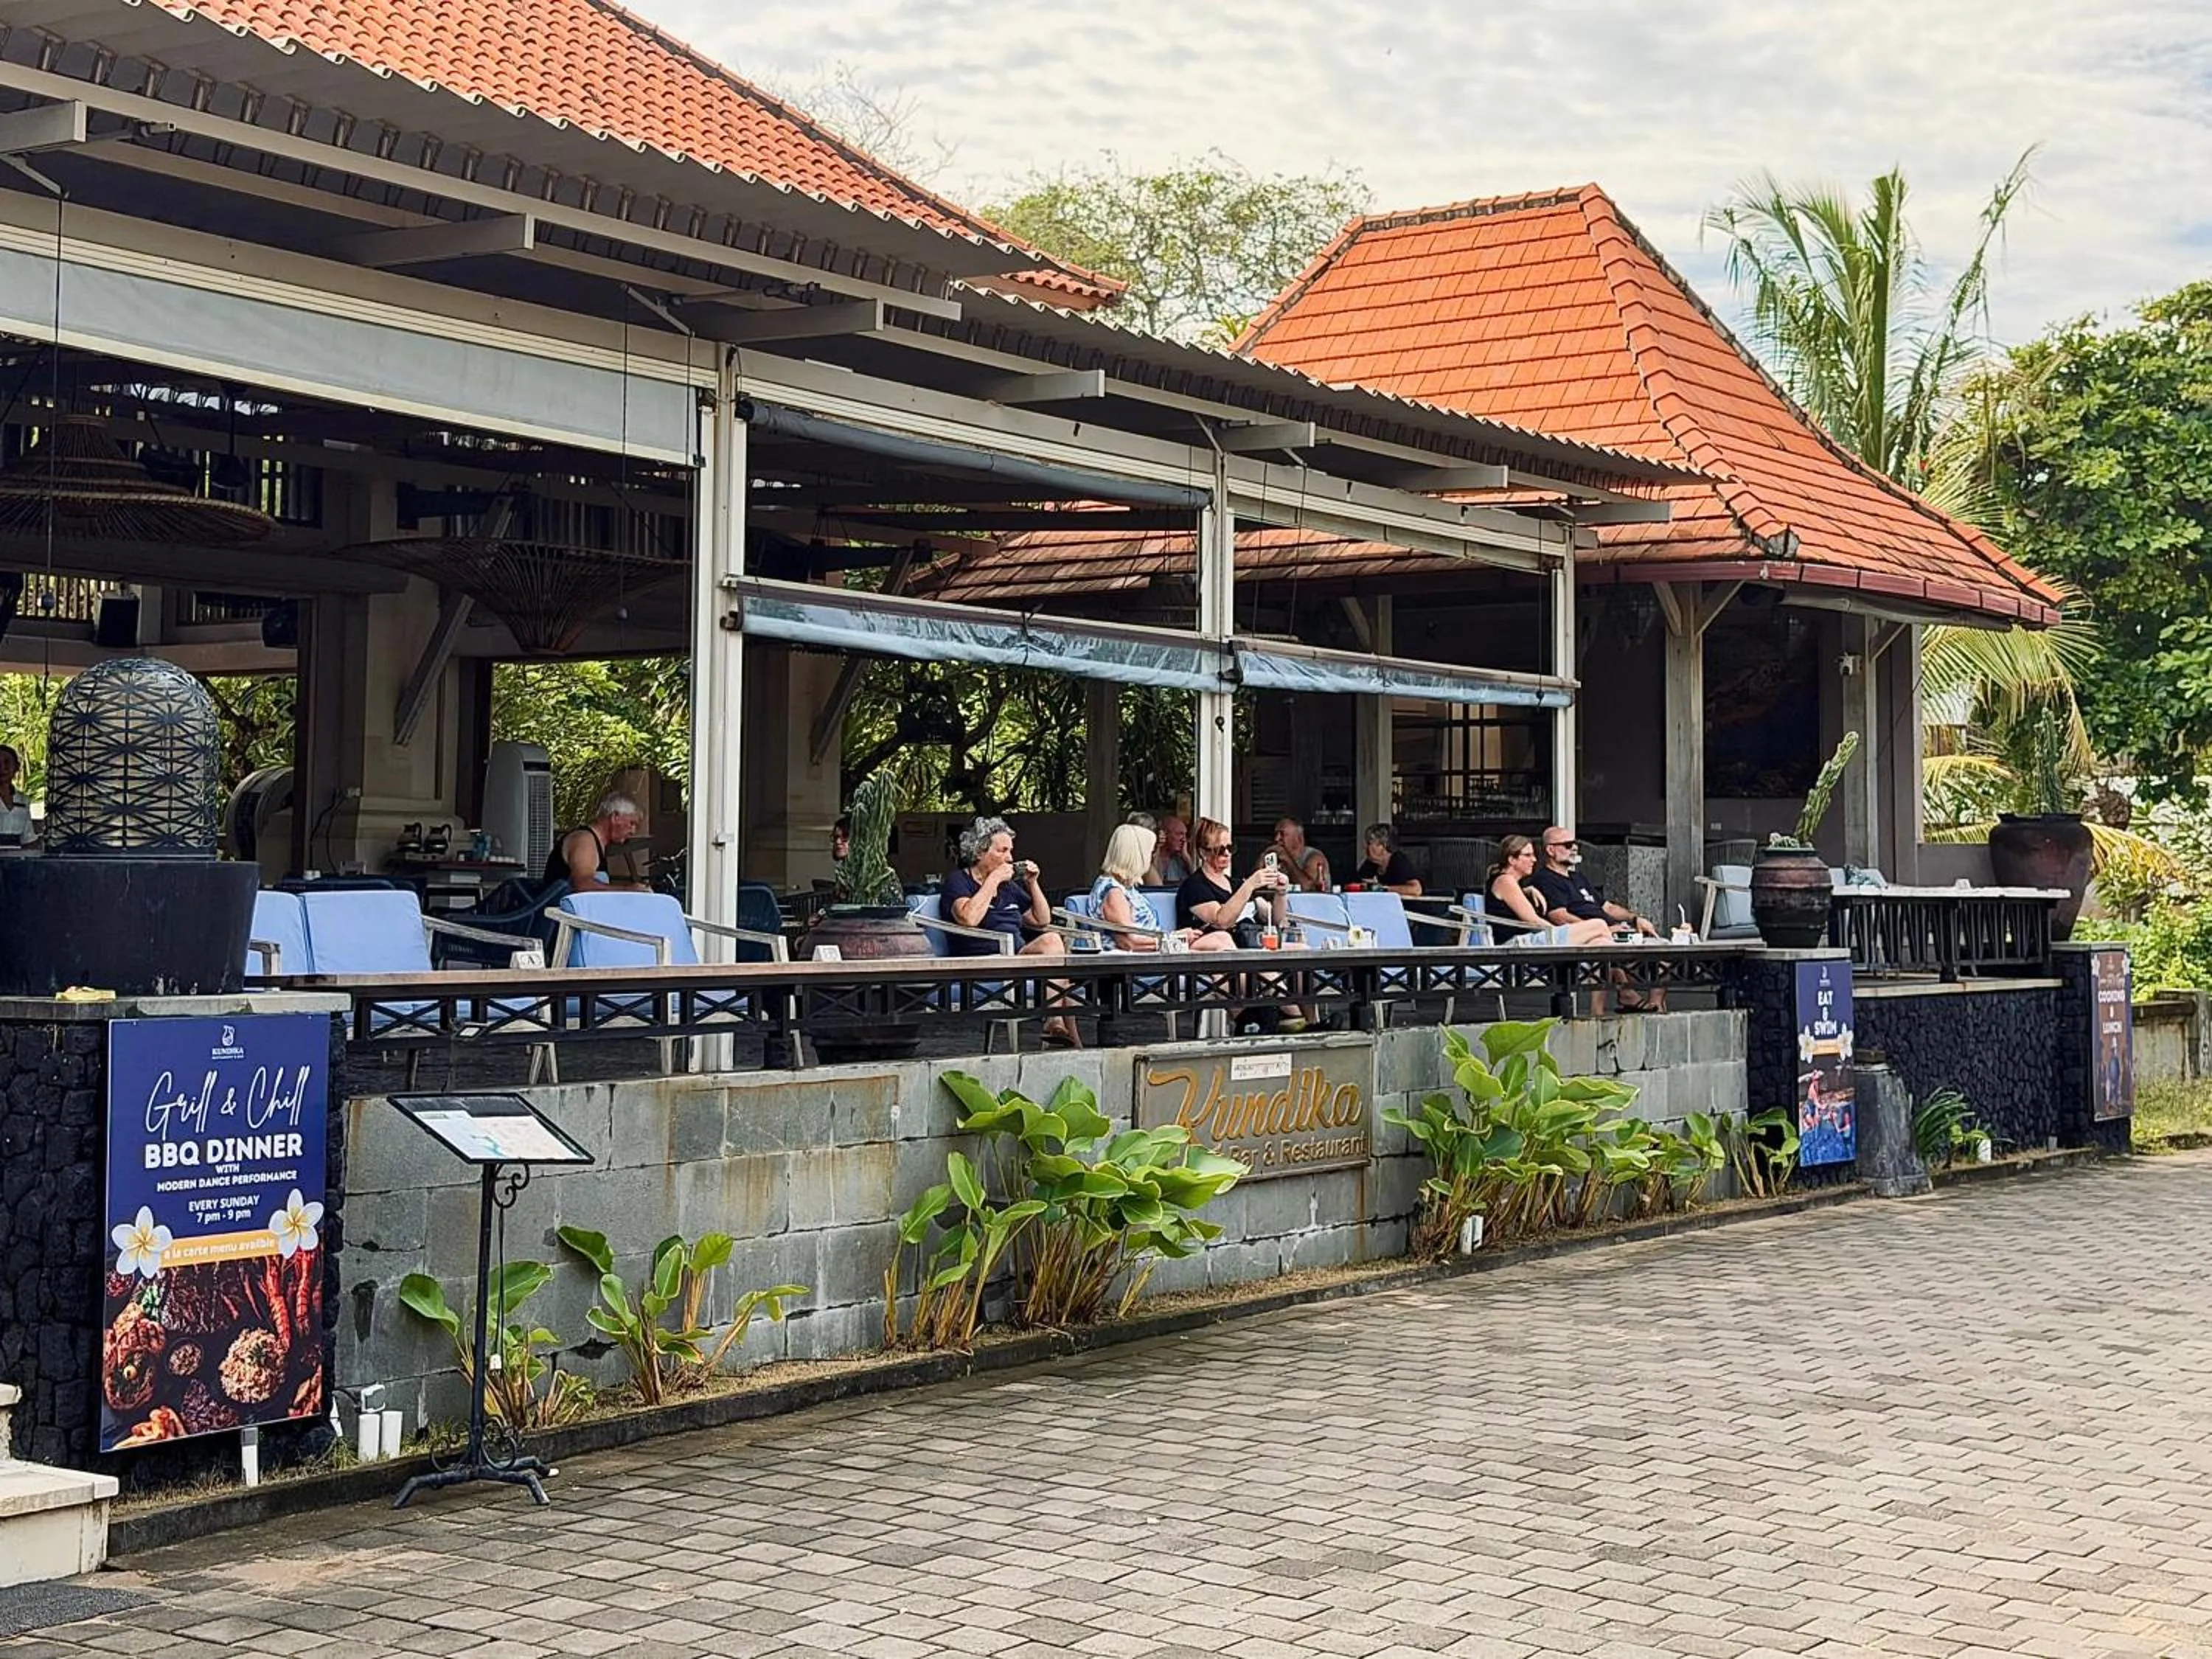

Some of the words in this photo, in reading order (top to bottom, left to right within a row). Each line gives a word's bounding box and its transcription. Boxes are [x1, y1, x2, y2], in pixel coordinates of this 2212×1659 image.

[1818, 990, 1834, 1006] EAT
[1815, 1020, 1837, 1036] SWIM
[146, 1071, 218, 1141] Grill
[221, 1088, 236, 1116] &
[247, 1066, 310, 1129] Chill
[1147, 1065, 1363, 1149] Kundika
[145, 1141, 200, 1169] BBQ
[206, 1133, 303, 1164] DINNER
[1264, 1141, 1275, 1166] &
[1280, 1131, 1366, 1164] Restaurant
[215, 1164, 240, 1173] WITH
[157, 1179, 197, 1192] MODERN
[198, 1175, 231, 1188] DANCE
[232, 1170, 297, 1185] PERFORMANCE
[188, 1200, 219, 1212] EVERY
[220, 1194, 260, 1208] SUNDAY
[196, 1212, 204, 1223] 7
[204, 1212, 220, 1224] pm
[227, 1210, 234, 1220] 9
[235, 1209, 251, 1221] pm
[183, 1245, 209, 1257] carte
[209, 1243, 237, 1253] menu
